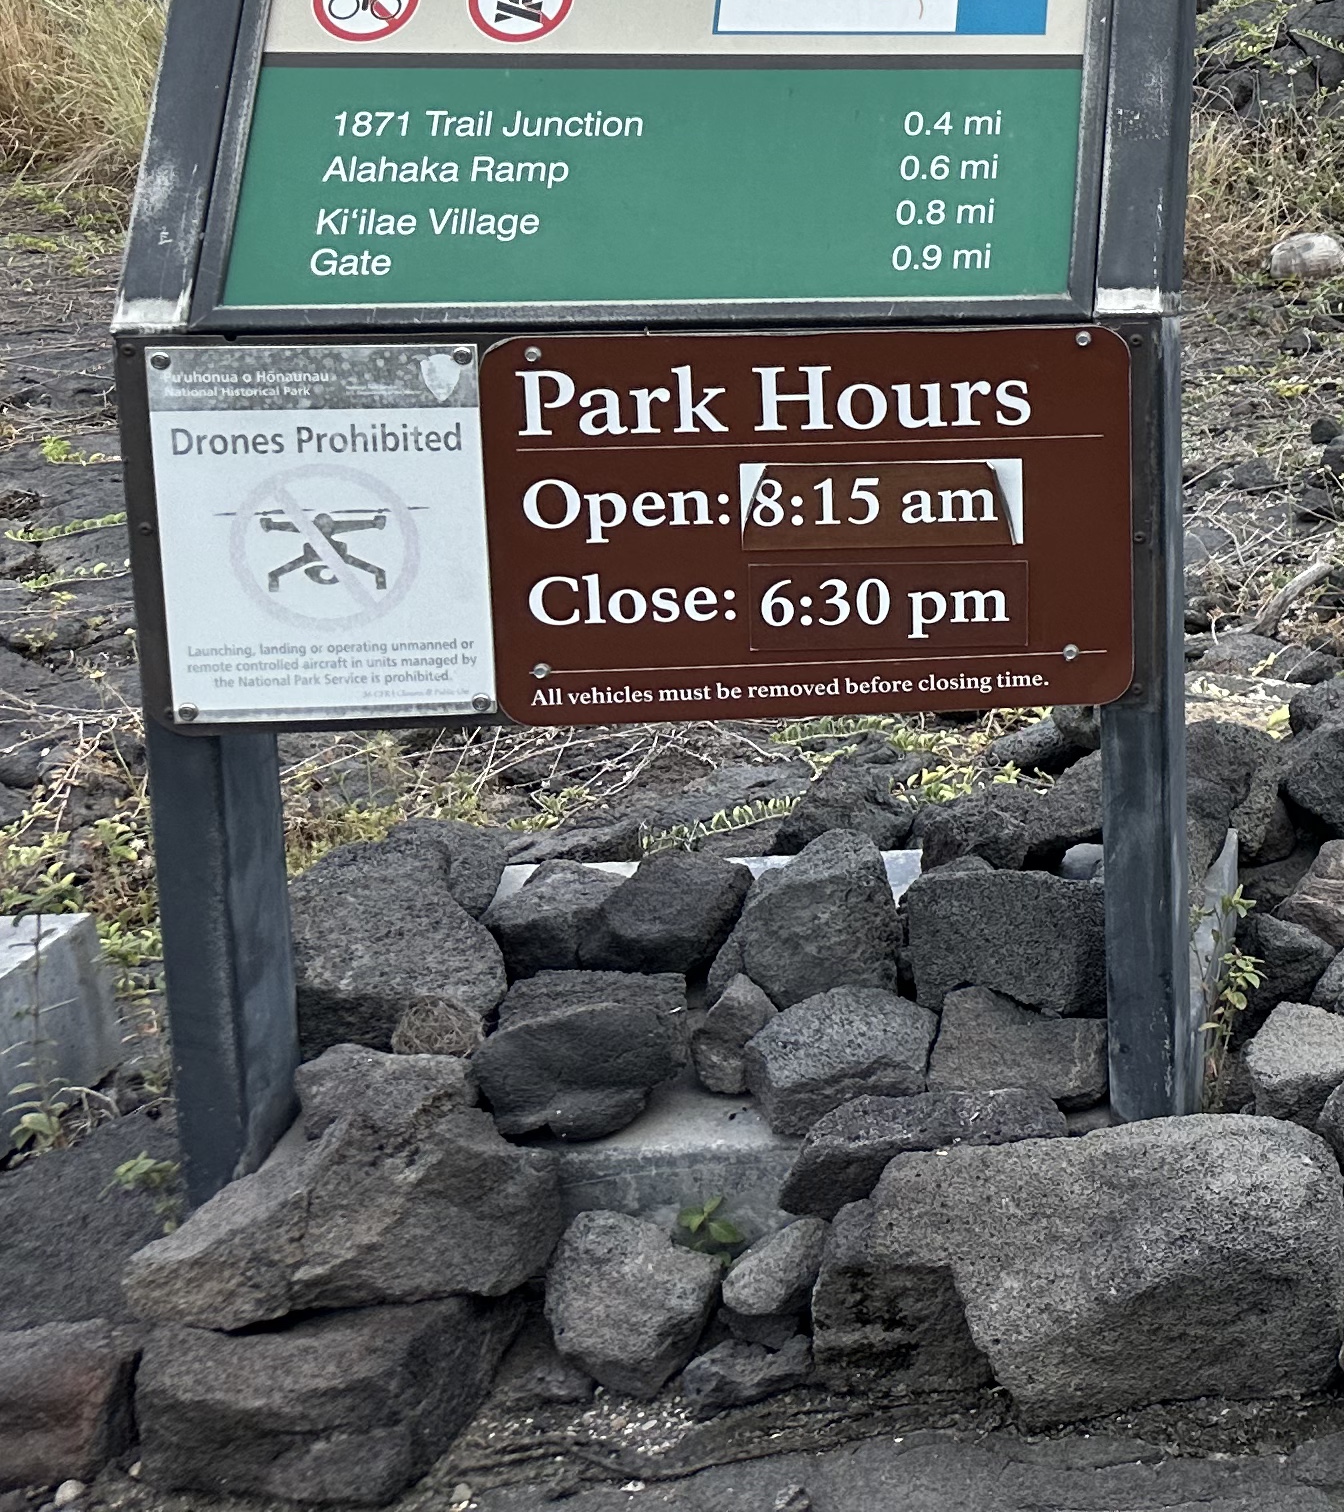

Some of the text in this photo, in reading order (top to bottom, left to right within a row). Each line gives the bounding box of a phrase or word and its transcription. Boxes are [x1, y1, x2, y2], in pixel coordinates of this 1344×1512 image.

[333, 110, 644, 137] 1871 Trail Junction
[904, 110, 1002, 136] 0.4 mi
[322, 155, 569, 188] Alahaka Ramp
[899, 153, 999, 182] 0.6 mi
[428, 208, 540, 241] Village
[895, 198, 995, 227] 0.8 mi
[309, 248, 392, 276] Gate
[891, 243, 992, 272] 0.9 mi
[165, 386, 310, 397] National Historical Park
[242, 373, 252, 383] o
[515, 365, 1032, 438] Park Hours
[170, 422, 462, 455] Drones Prohibited
[523, 476, 999, 543] Open: 8:15 am
[528, 574, 1010, 639] Close: 6:30 pm
[187, 638, 474, 658] Launching, landing or operating unmanned or
[187, 653, 477, 673] remote controlled aircraft in units managed by
[214, 670, 452, 688] the National Park Service is prohibited.
[531, 671, 1049, 705] All vehicles must be removed before closing time.
